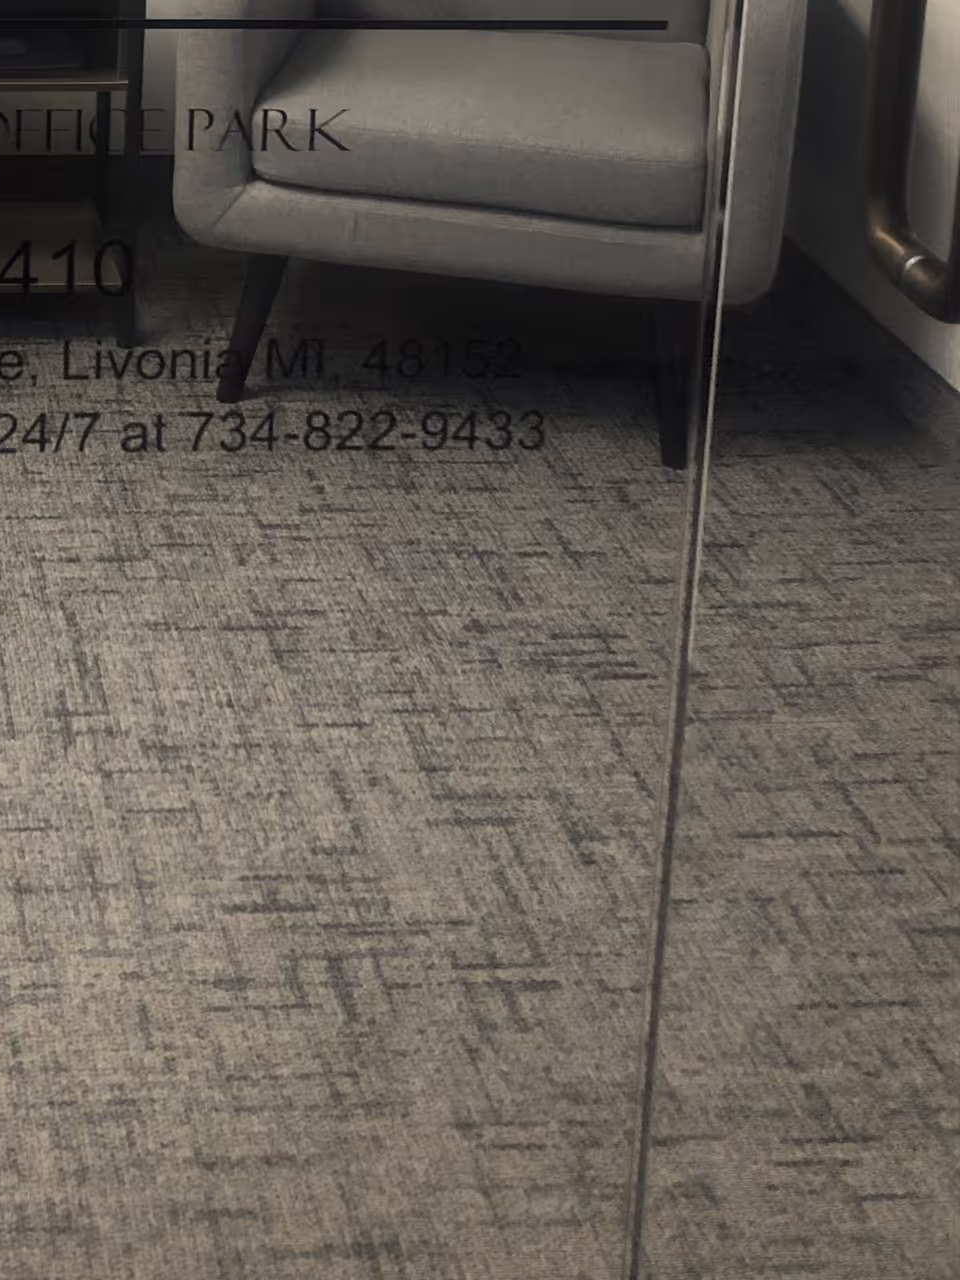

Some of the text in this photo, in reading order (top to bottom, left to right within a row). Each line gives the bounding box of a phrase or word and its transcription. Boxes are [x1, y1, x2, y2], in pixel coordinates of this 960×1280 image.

[186, 107, 352, 153] PARK
[62, 338, 243, 382] Livonia
[361, 336, 523, 381] 48152
[120, 412, 165, 453] at
[187, 408, 545, 453] 734-822-9433
